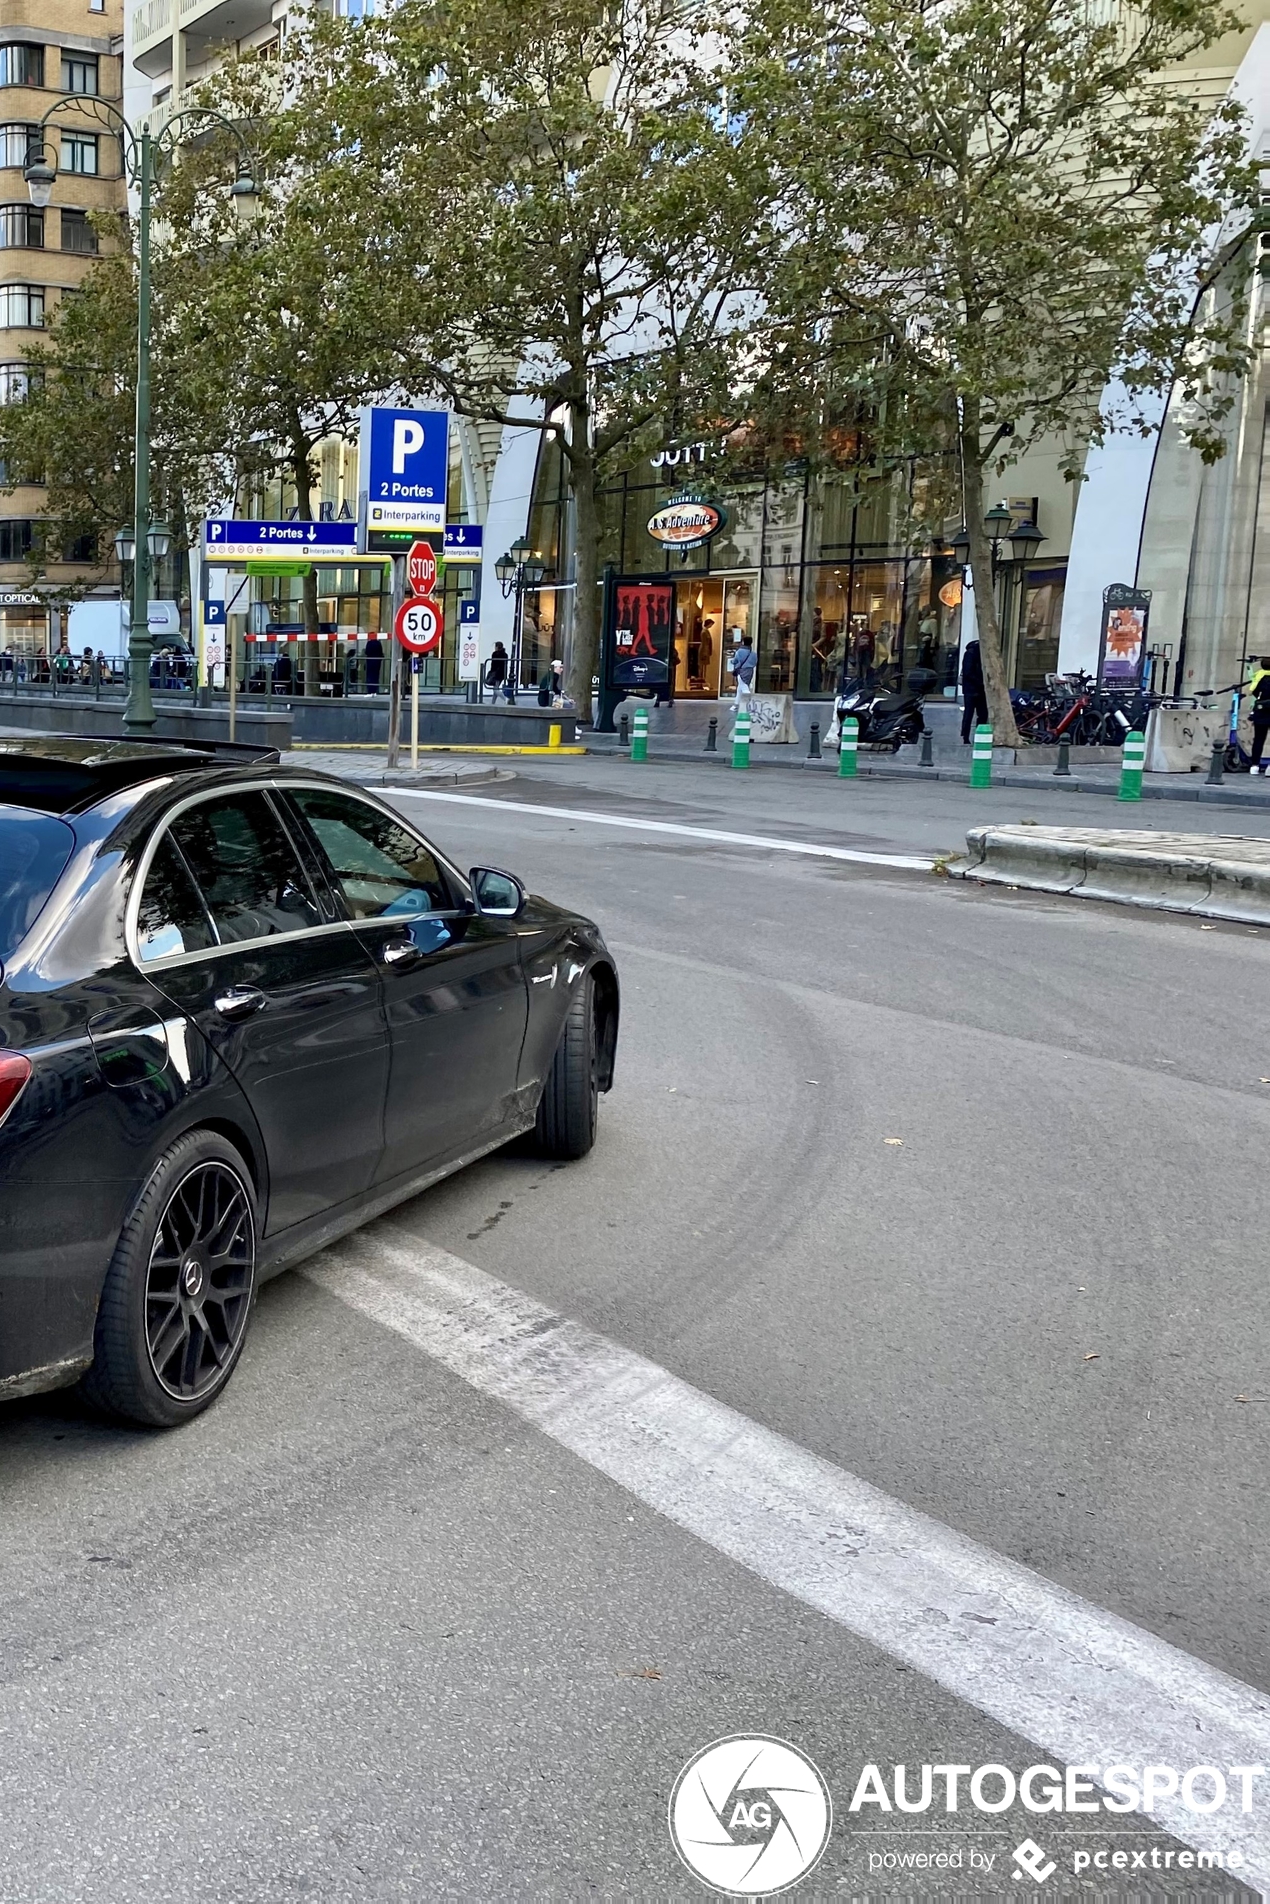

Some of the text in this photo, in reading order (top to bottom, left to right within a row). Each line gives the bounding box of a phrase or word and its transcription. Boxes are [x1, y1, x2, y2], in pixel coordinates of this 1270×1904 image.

[392, 419, 425, 474] P
[380, 482, 434, 497] 2 Portes
[667, 495, 702, 505] WELCOME TO
[285, 498, 354, 522] ZRA
[383, 510, 441, 523] Interparking
[211, 523, 304, 541] P 2 Portes
[309, 547, 345, 555] Interparking
[410, 558, 435, 580] STOP
[4, 594, 41, 603] OPTICAL
[209, 606, 219, 620] P
[466, 606, 475, 619] P
[408, 613, 432, 631] 50
[413, 632, 426, 641] km
